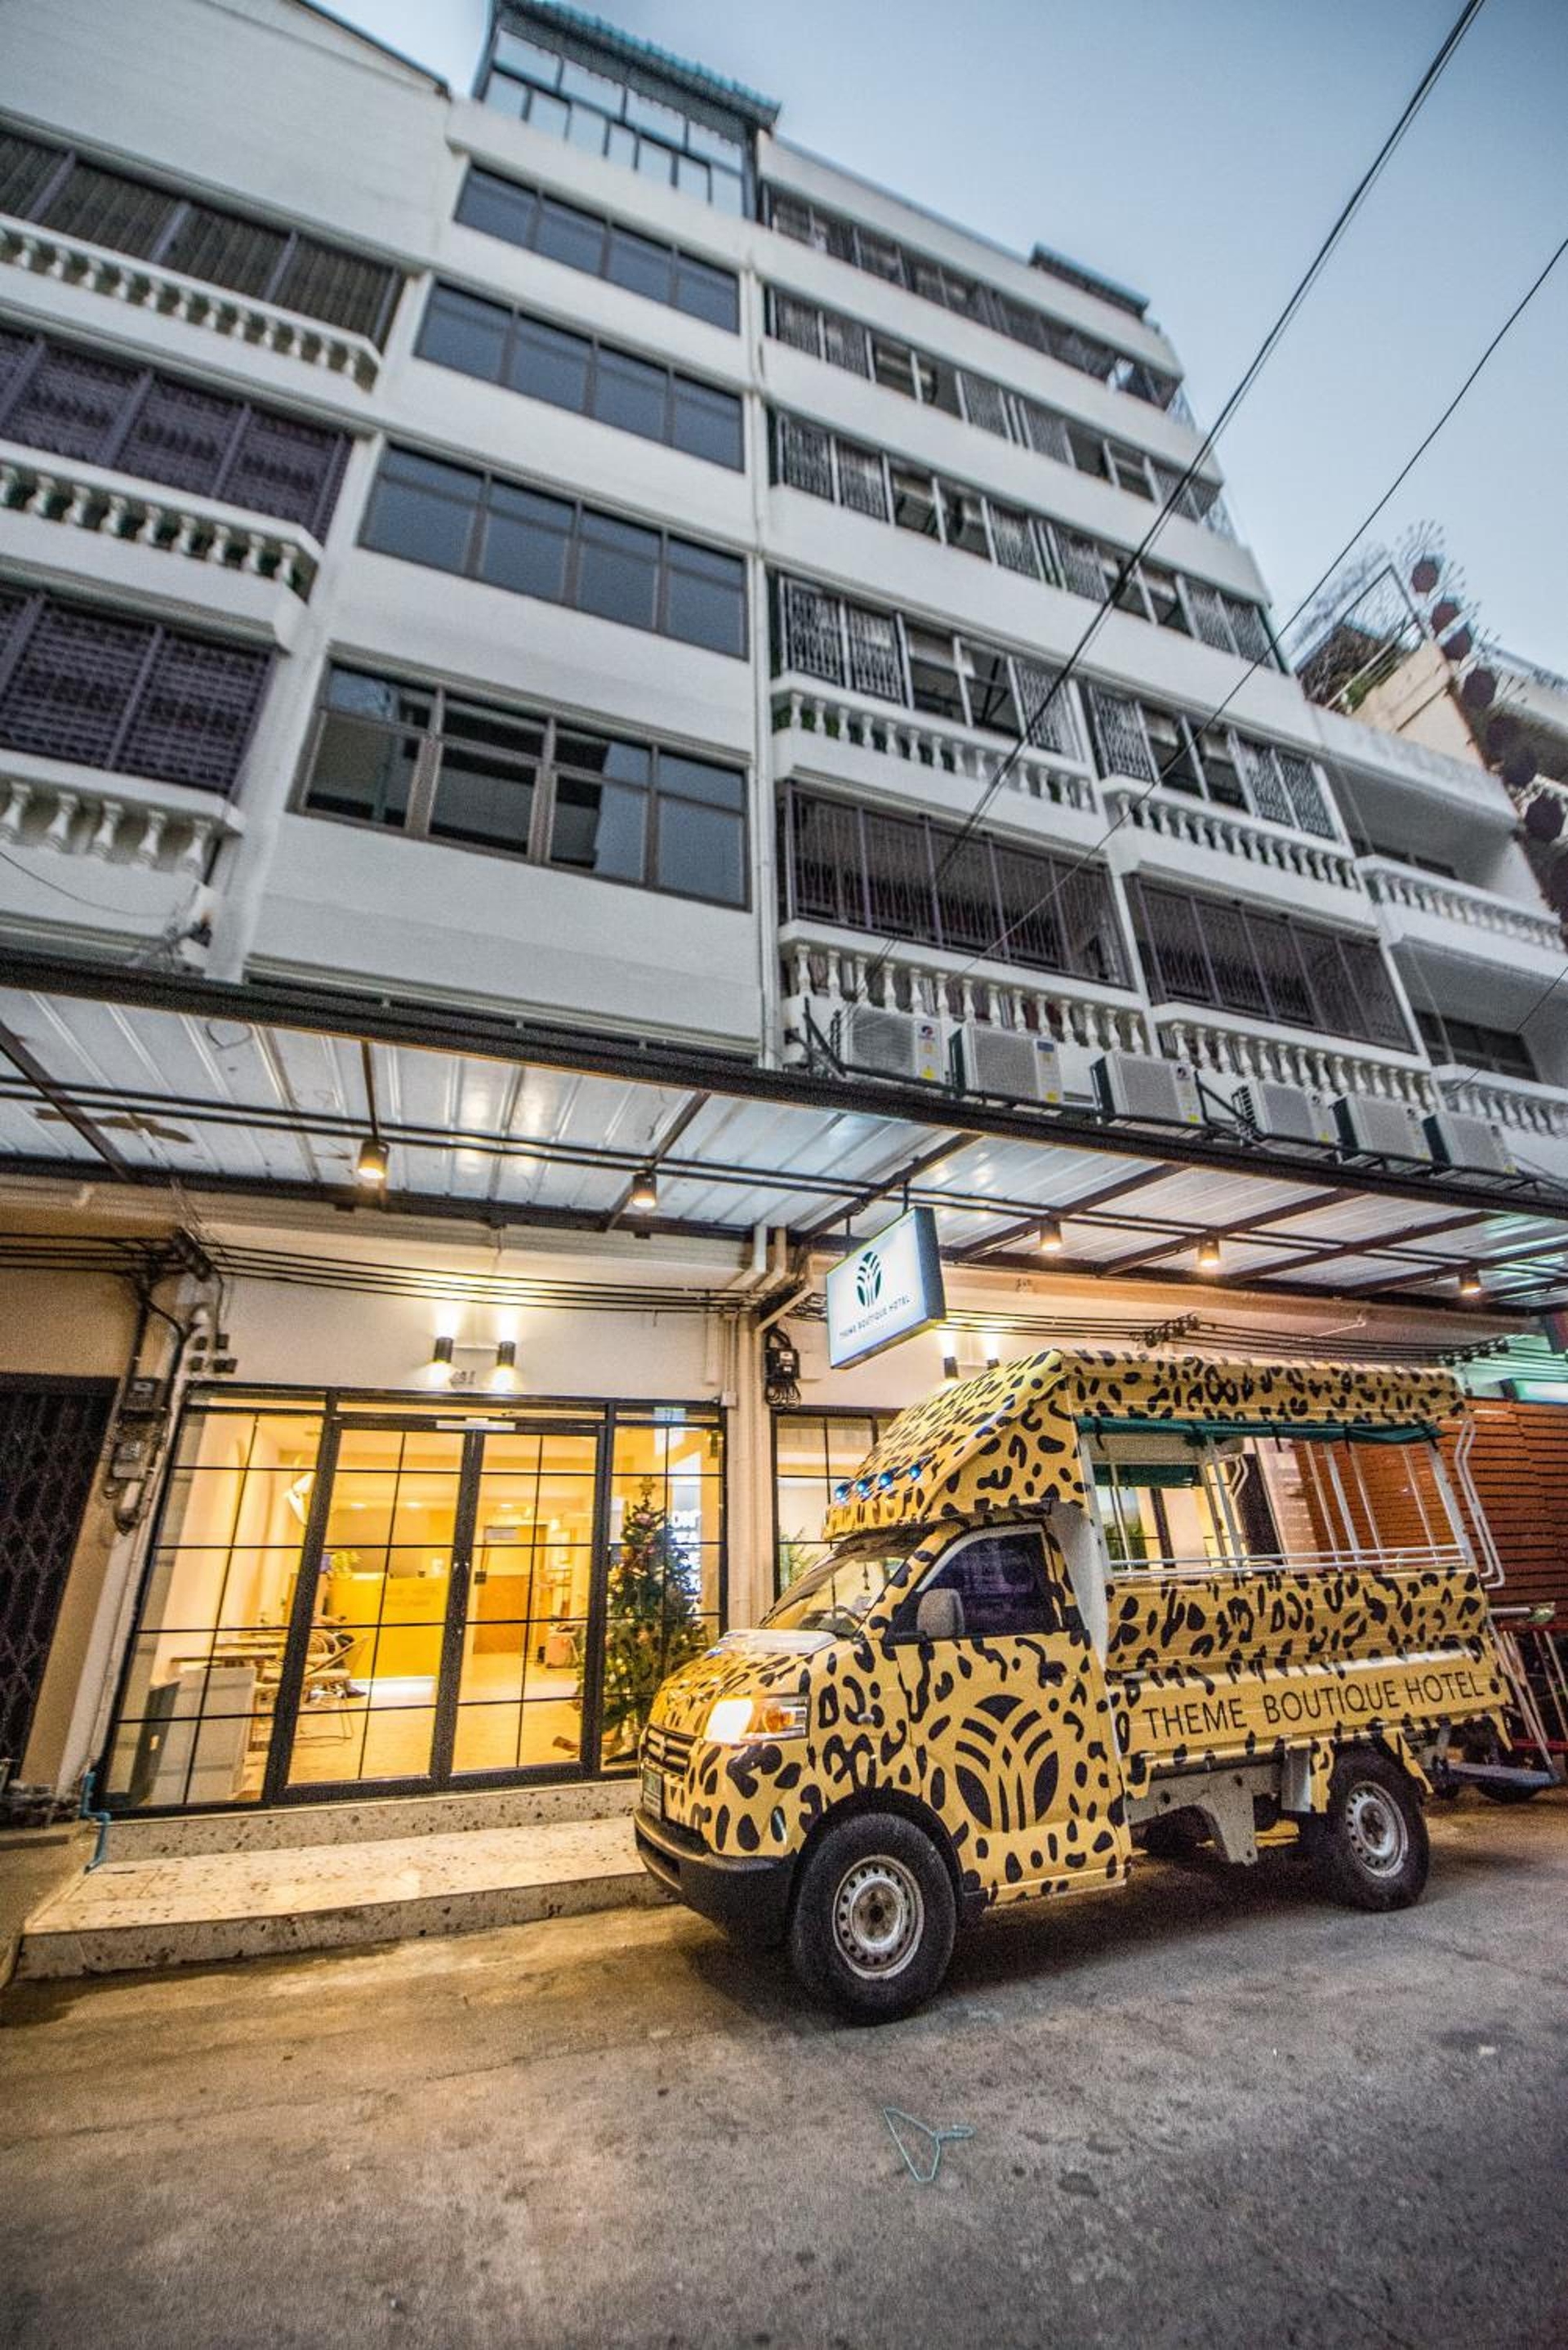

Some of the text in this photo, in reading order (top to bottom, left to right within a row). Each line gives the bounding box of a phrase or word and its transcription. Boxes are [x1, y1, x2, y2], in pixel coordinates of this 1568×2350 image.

[1142, 1671, 1485, 1739] THEME BOUTIQUE HOTEL
